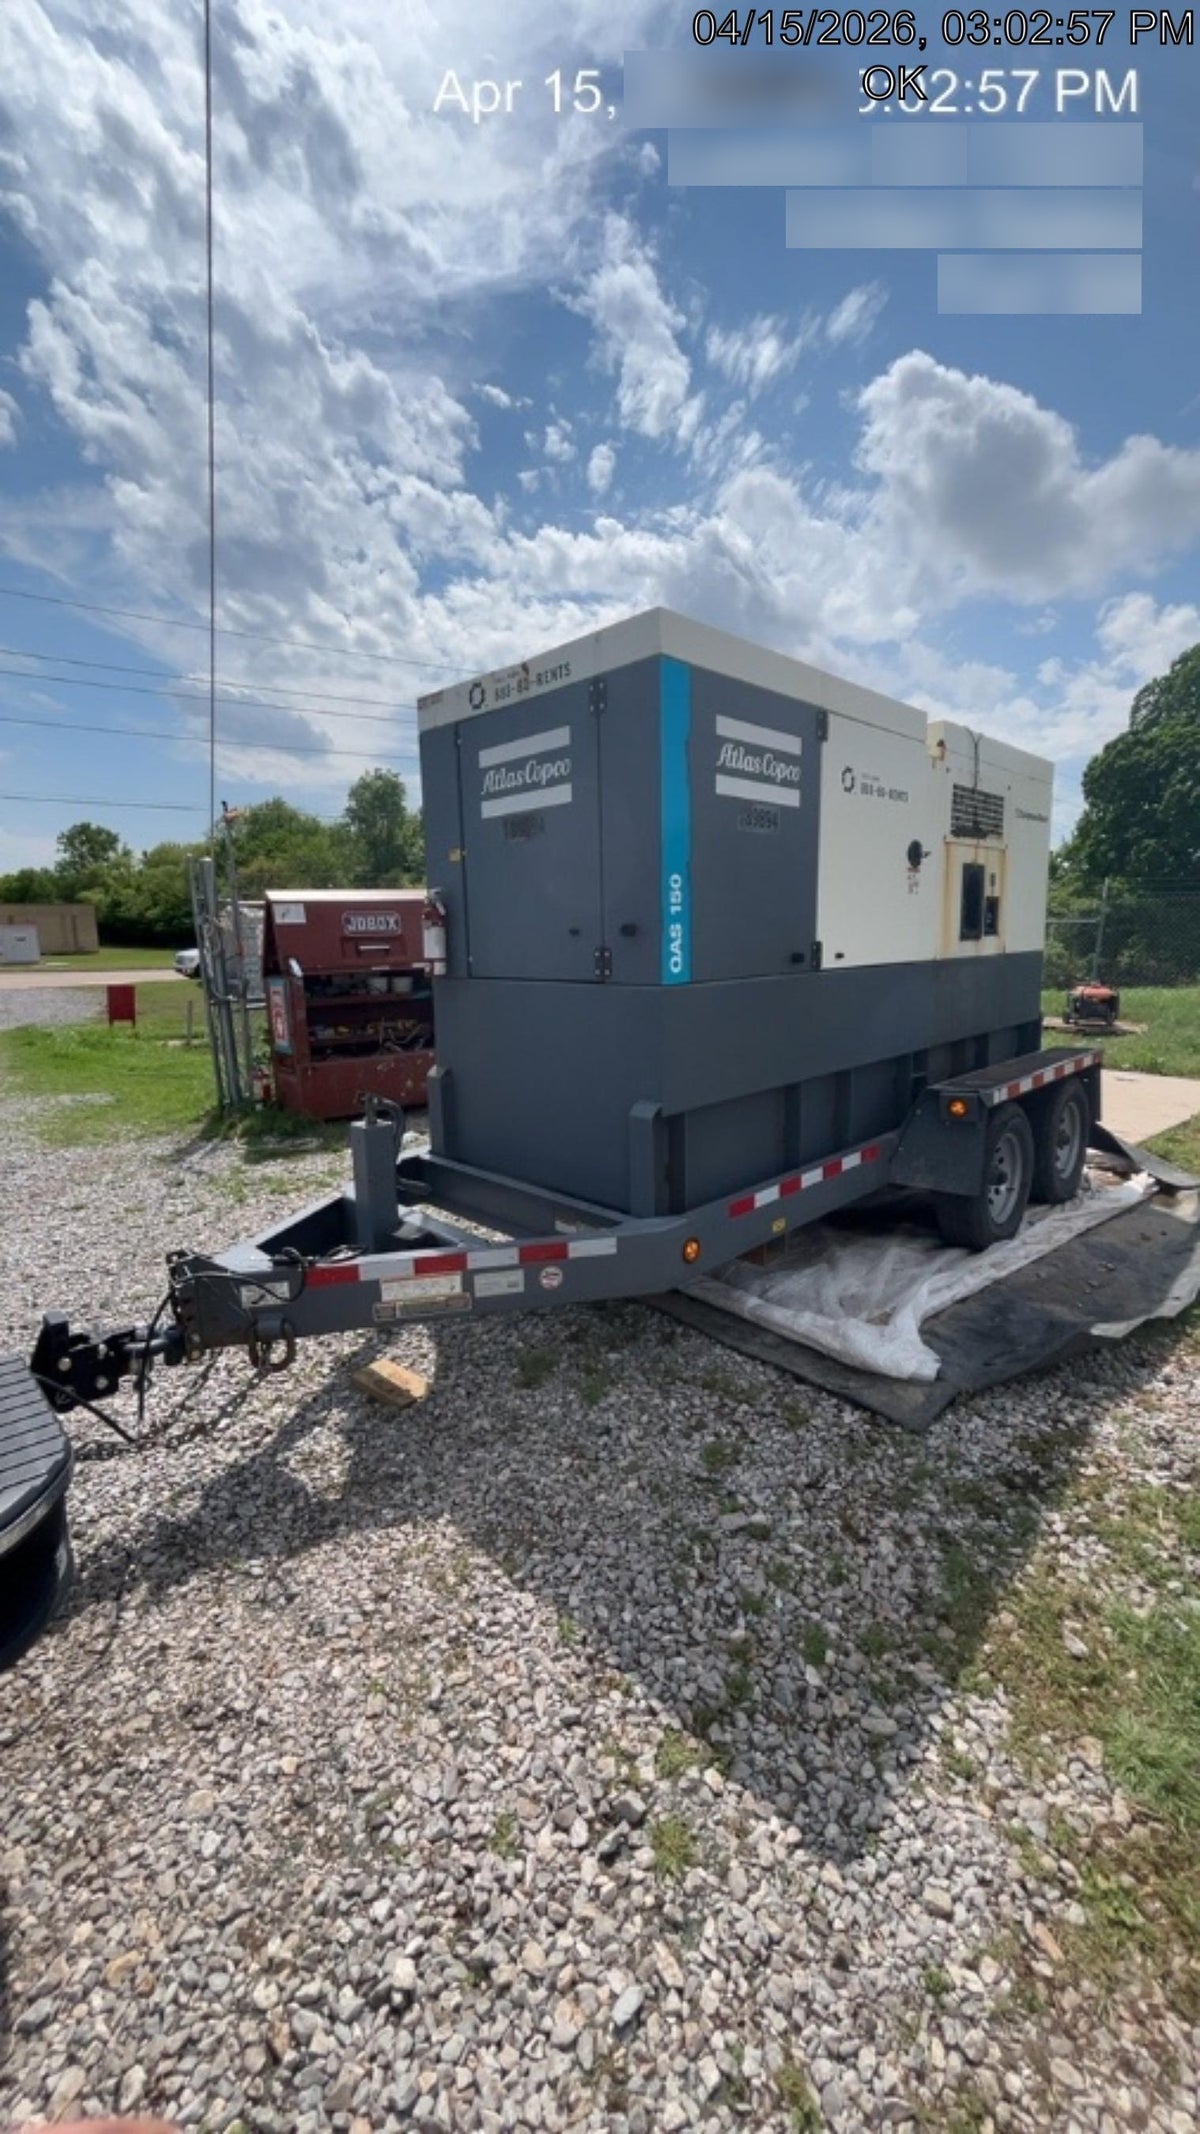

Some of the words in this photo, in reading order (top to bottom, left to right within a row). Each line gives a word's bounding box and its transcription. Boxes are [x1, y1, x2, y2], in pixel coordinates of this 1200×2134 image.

[480, 767, 524, 795] Atlas
[525, 758, 571, 786] Copco
[716, 743, 760, 775] Atlas
[762, 753, 801, 783] Copco
[670, 873, 682, 916] 150
